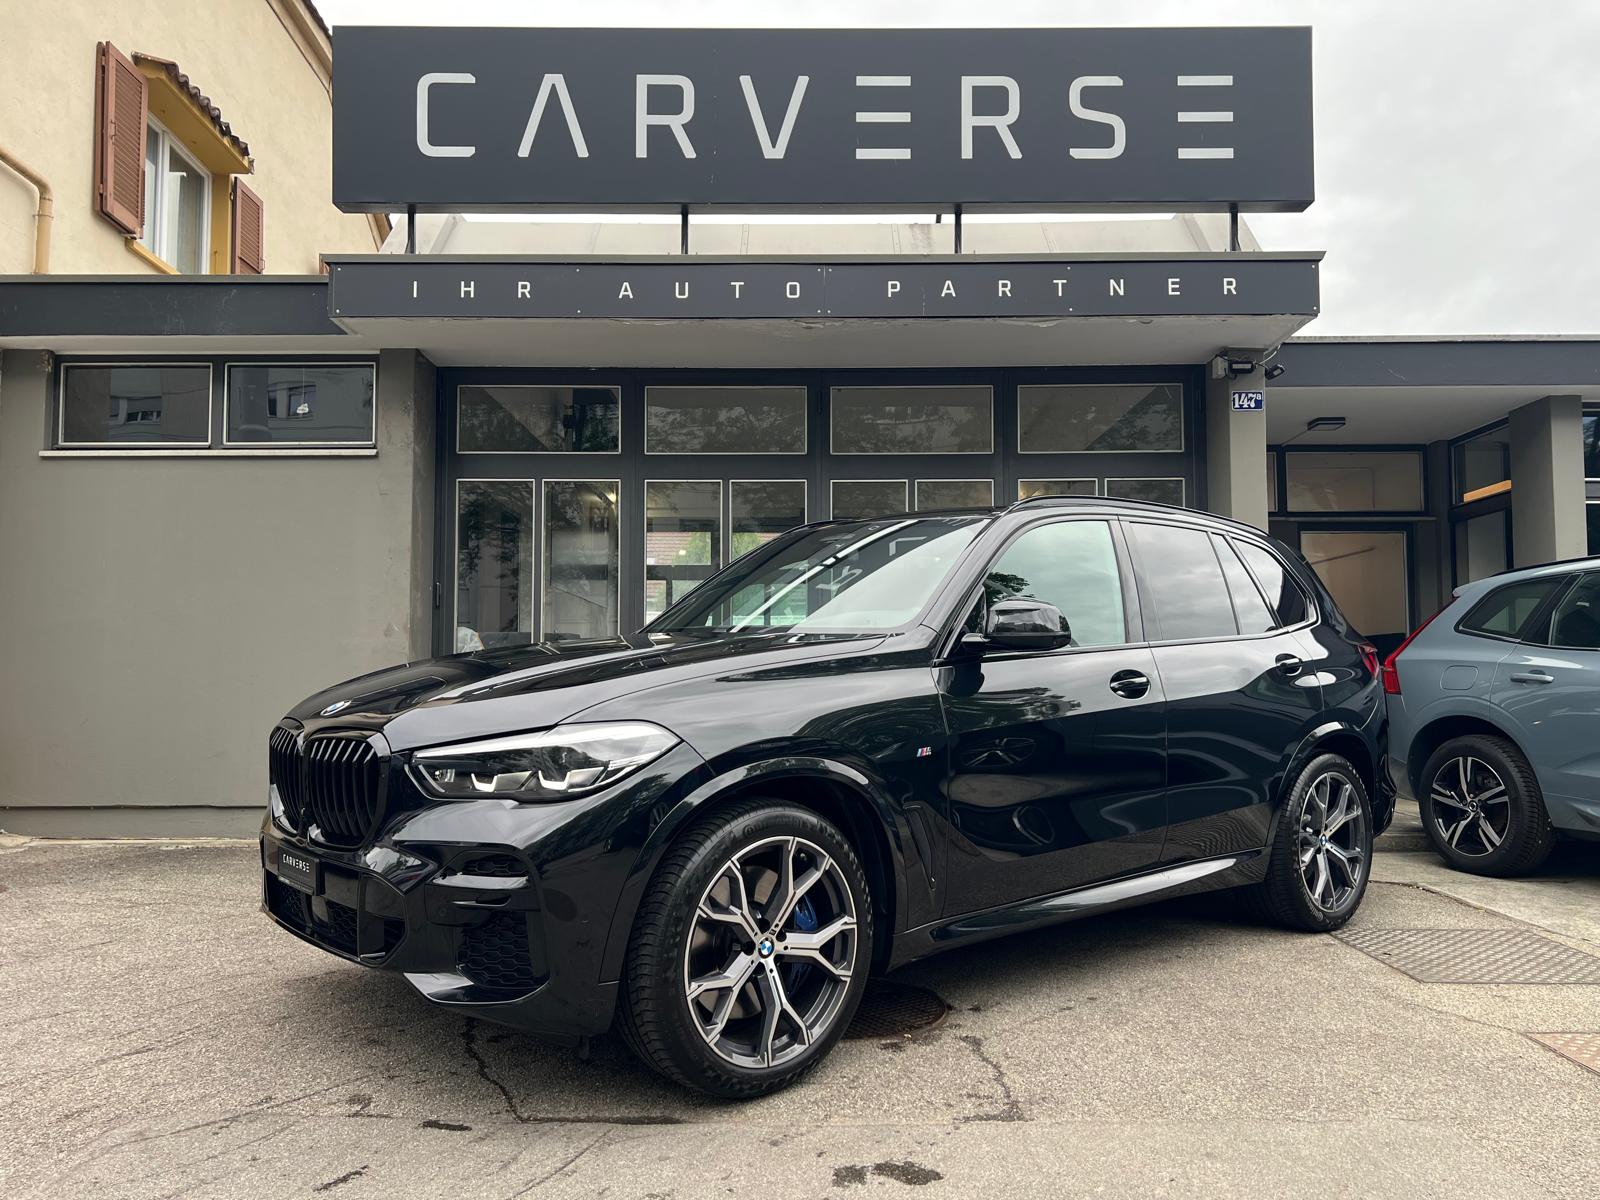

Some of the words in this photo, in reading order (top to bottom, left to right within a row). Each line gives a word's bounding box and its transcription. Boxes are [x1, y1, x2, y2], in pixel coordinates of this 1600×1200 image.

[416, 72, 1234, 160] CARVERSE
[412, 280, 532, 299] IHR
[618, 281, 802, 299] AUTO
[887, 277, 1237, 298] PARTNER
[282, 853, 310, 873] CARVERSE
